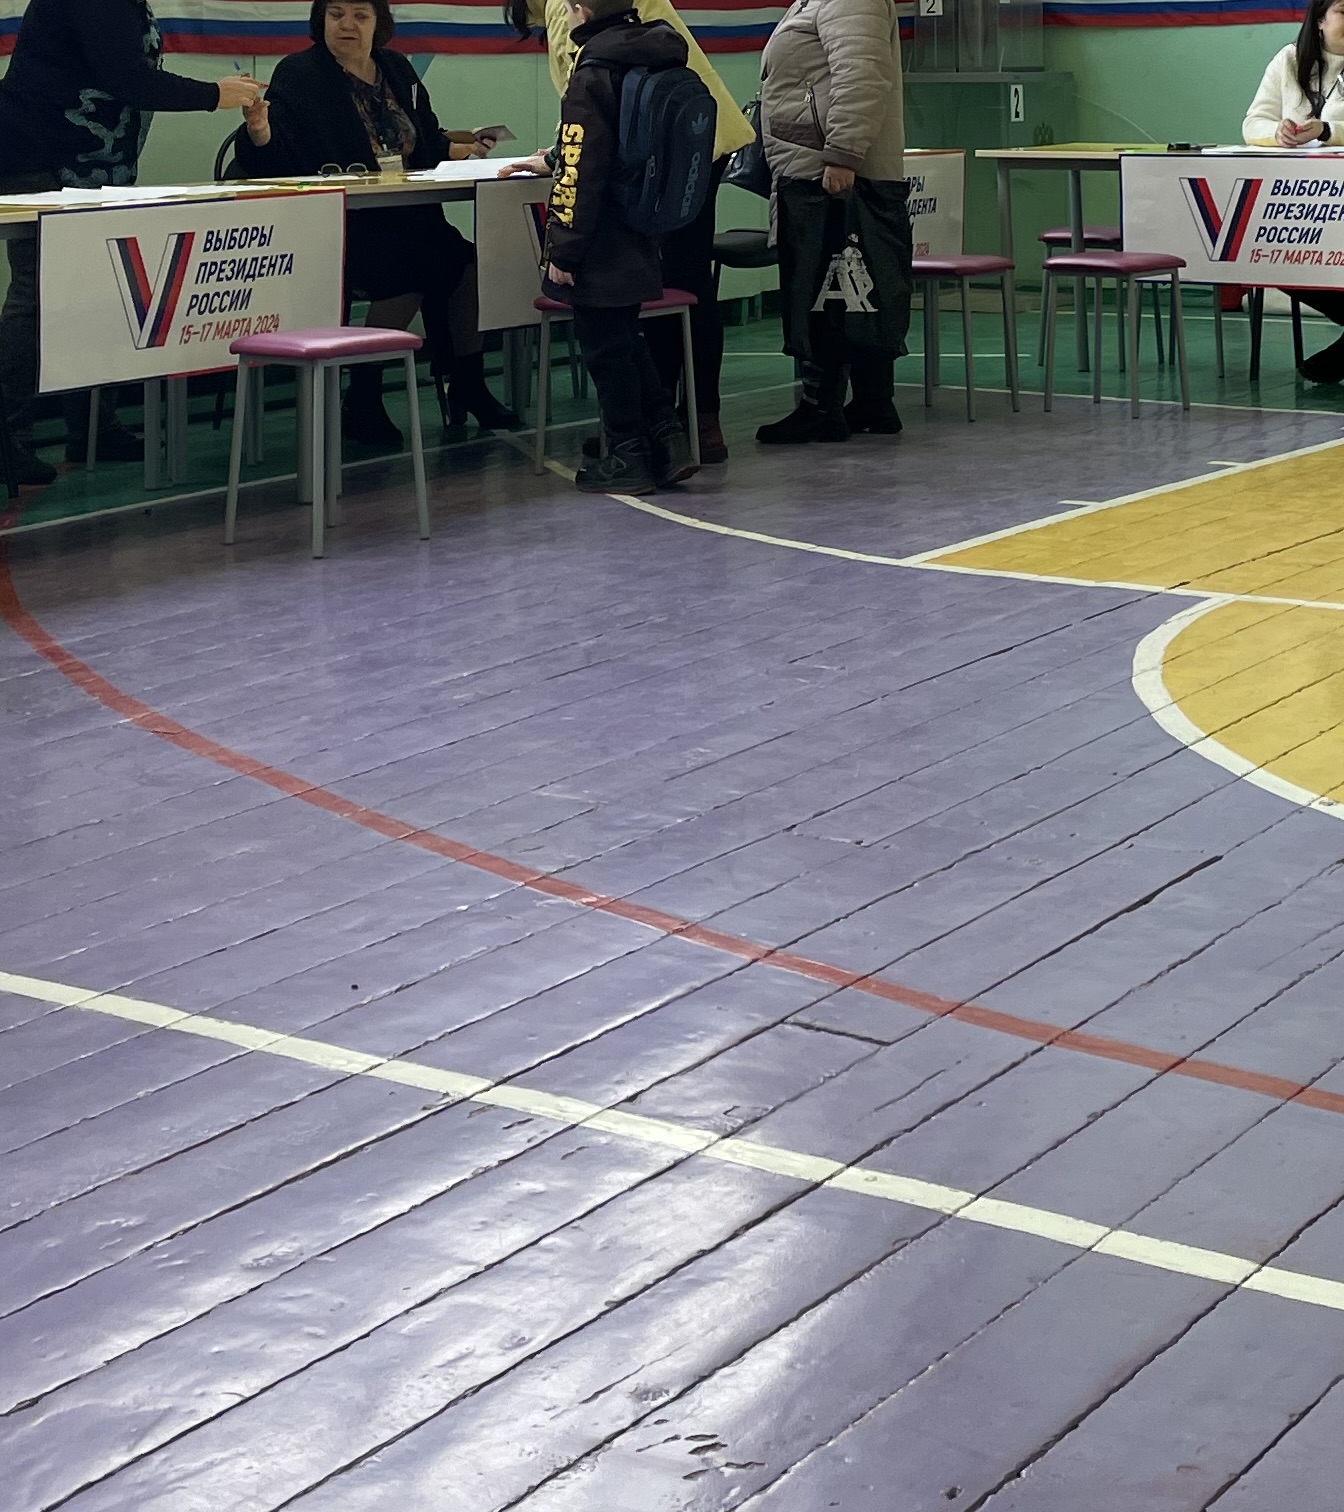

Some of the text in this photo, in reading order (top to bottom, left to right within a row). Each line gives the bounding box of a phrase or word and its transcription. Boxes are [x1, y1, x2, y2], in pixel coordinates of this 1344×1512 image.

[549, 123, 585, 228] SPORT
[680, 152, 700, 218] adidas
[203, 225, 274, 252] ВЫБОРЫ
[1255, 226, 1323, 245] РОССИИ
[195, 253, 294, 284] ПРЕЗИДЕНТА
[1283, 251, 1323, 266] МАРТА
[186, 288, 253, 317] РОССИИ
[213, 317, 252, 341] МАРТА
[253, 314, 280, 335] 2024
